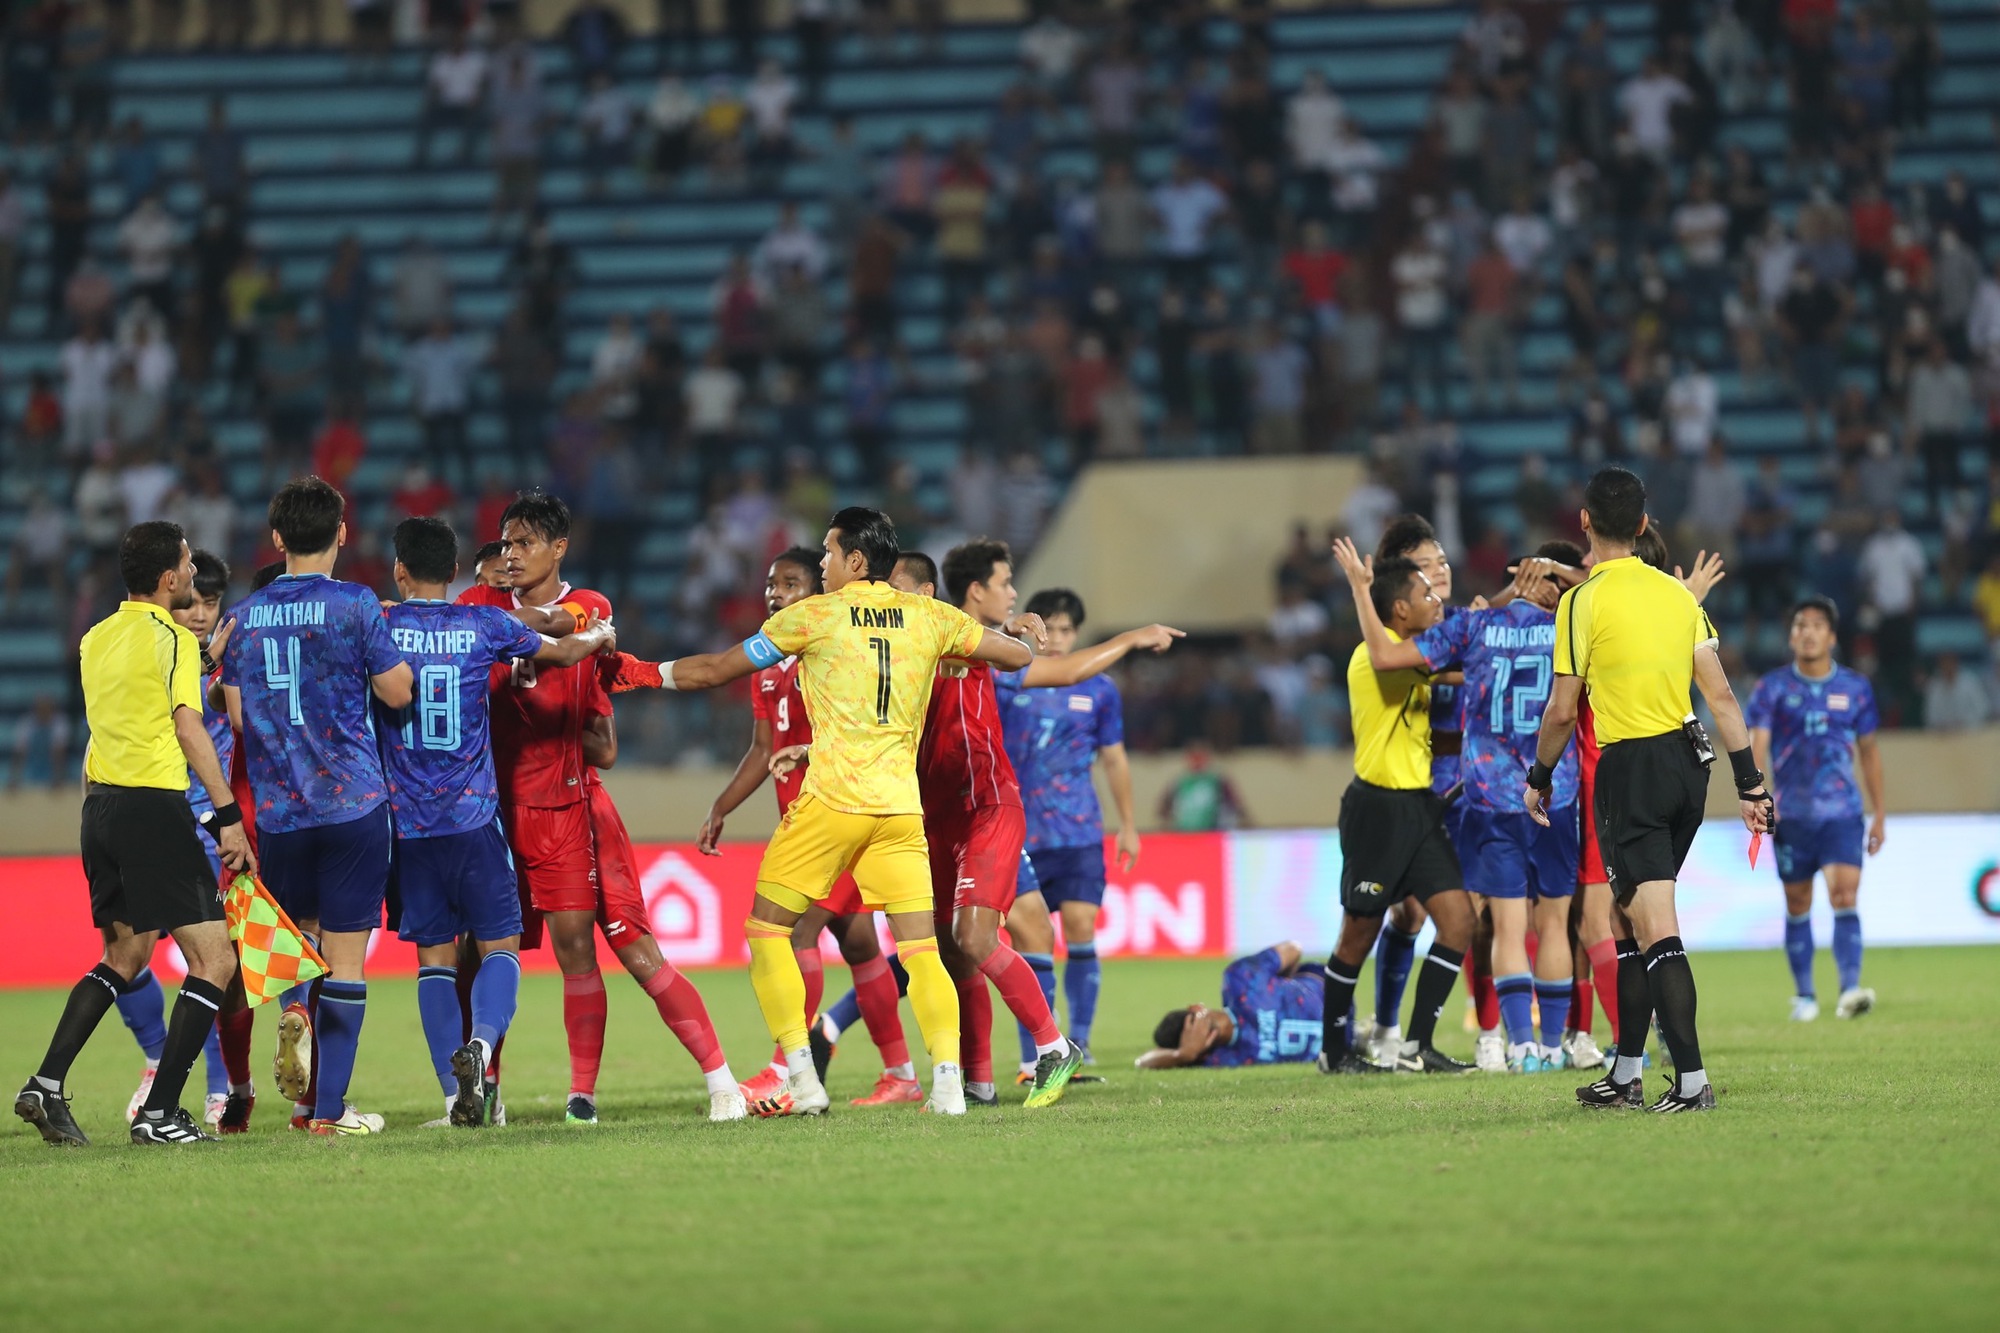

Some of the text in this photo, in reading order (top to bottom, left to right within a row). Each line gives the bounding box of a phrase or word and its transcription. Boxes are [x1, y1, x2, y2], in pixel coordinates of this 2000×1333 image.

[244, 602, 325, 629] JONATHAN
[850, 607, 904, 628] KAWIN
[391, 628, 475, 654] EERATHEP
[750, 638, 770, 660] C
[263, 636, 304, 726] 4
[511, 656, 538, 689] 19
[869, 637, 891, 724] 1
[1491, 655, 1552, 735] 12
[777, 696, 790, 731] 9
[1037, 717, 1056, 749] 7
[85, 972, 112, 988] ELME
